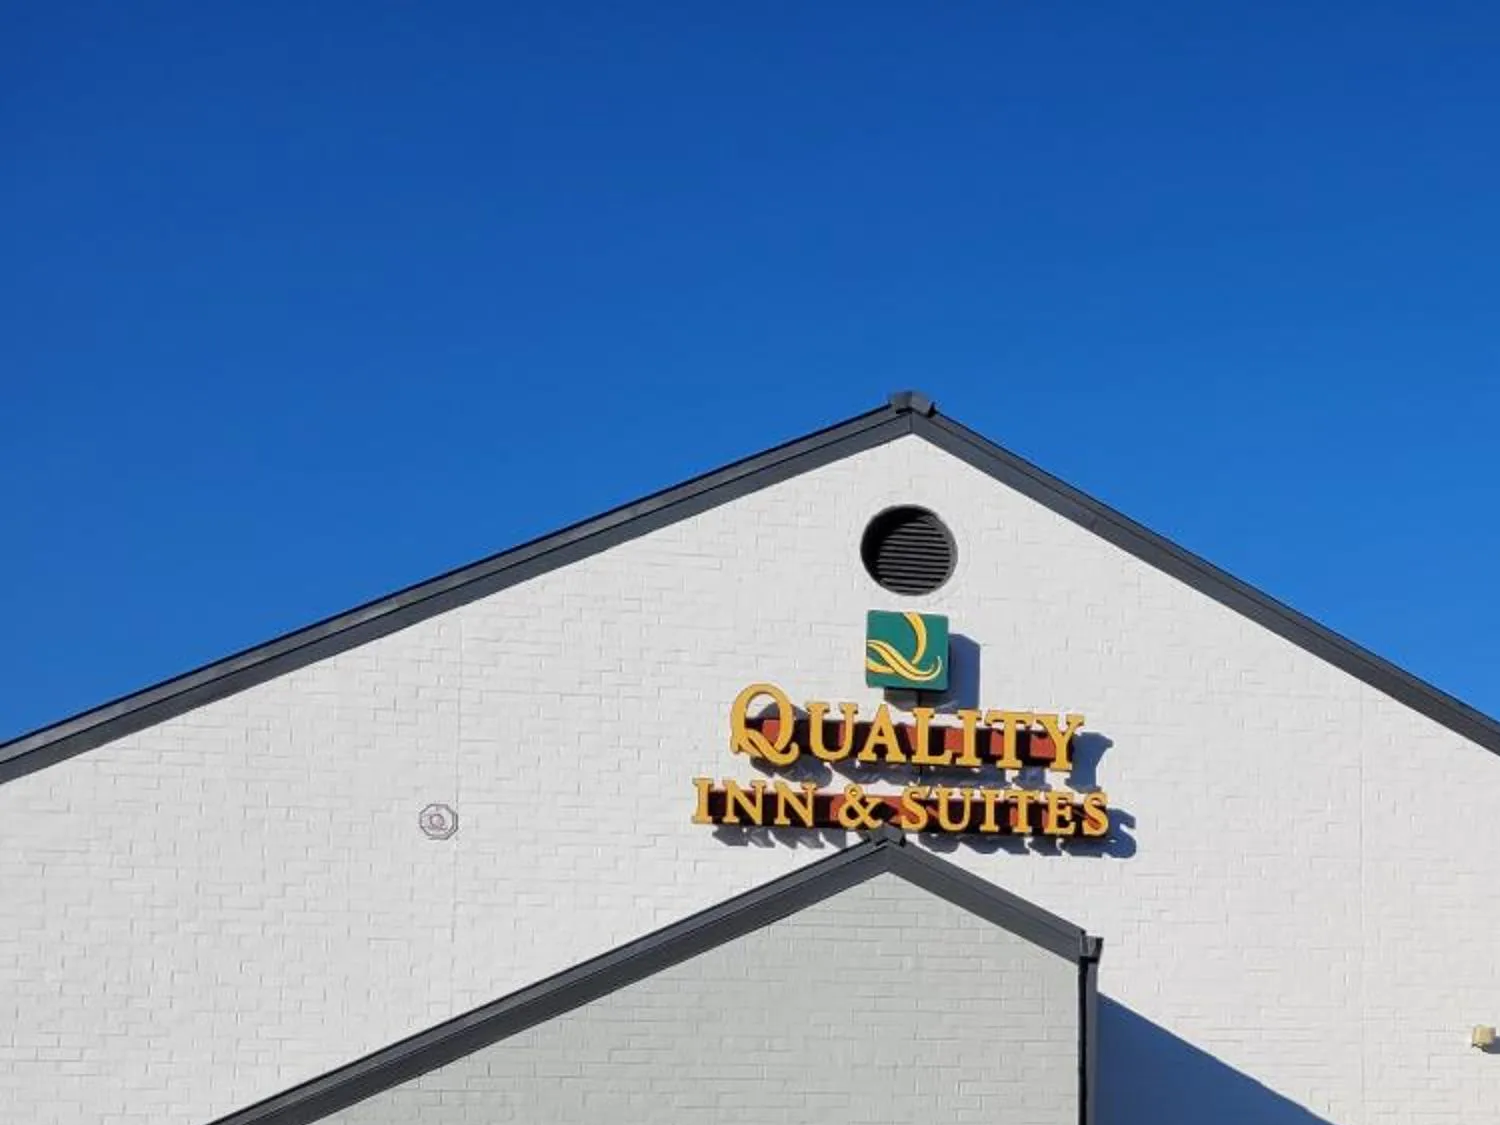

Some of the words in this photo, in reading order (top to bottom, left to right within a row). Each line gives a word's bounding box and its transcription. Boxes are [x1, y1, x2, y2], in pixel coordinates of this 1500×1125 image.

[730, 682, 1085, 772] QUALITY
[691, 777, 817, 827] INN
[838, 783, 884, 830] &
[901, 786, 1109, 836] SUITES
